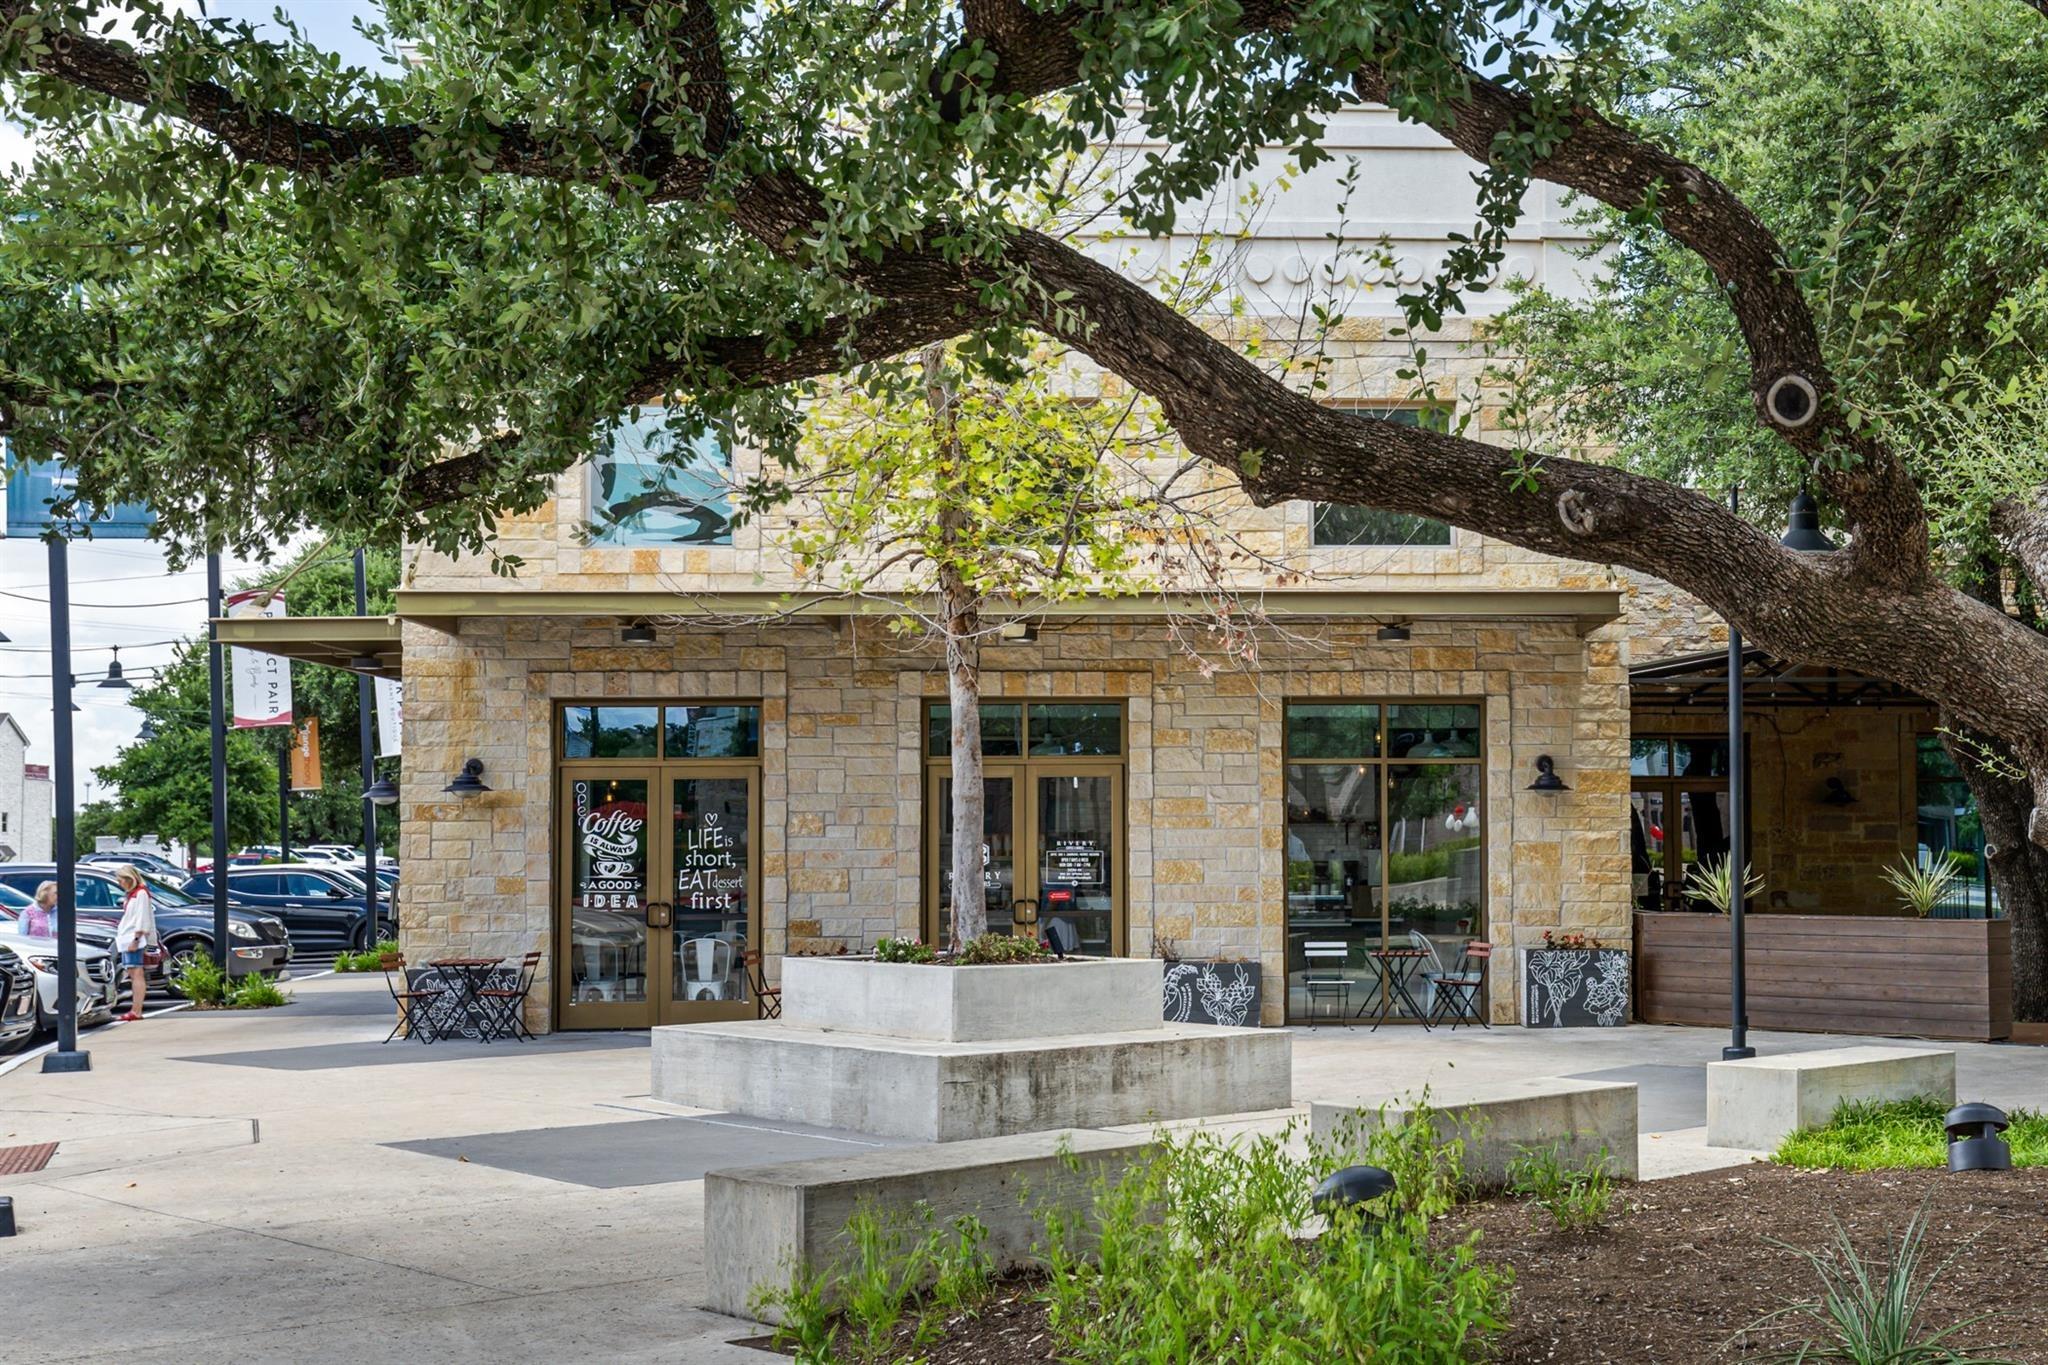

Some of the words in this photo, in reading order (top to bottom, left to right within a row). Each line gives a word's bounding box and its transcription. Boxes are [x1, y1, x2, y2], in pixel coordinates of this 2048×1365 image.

[268, 682, 279, 714] PAIR
[582, 809, 642, 838] Coffee
[590, 837, 598, 845] IS
[600, 841, 633, 854] ALWAYS
[688, 827, 723, 850] LIFE
[725, 835, 734, 847] is
[685, 850, 736, 869] short,
[588, 881, 597, 889] A
[598, 880, 632, 890] GOOD
[679, 869, 717, 890] EAT
[712, 874, 743, 889] dessert
[691, 892, 732, 909] first
